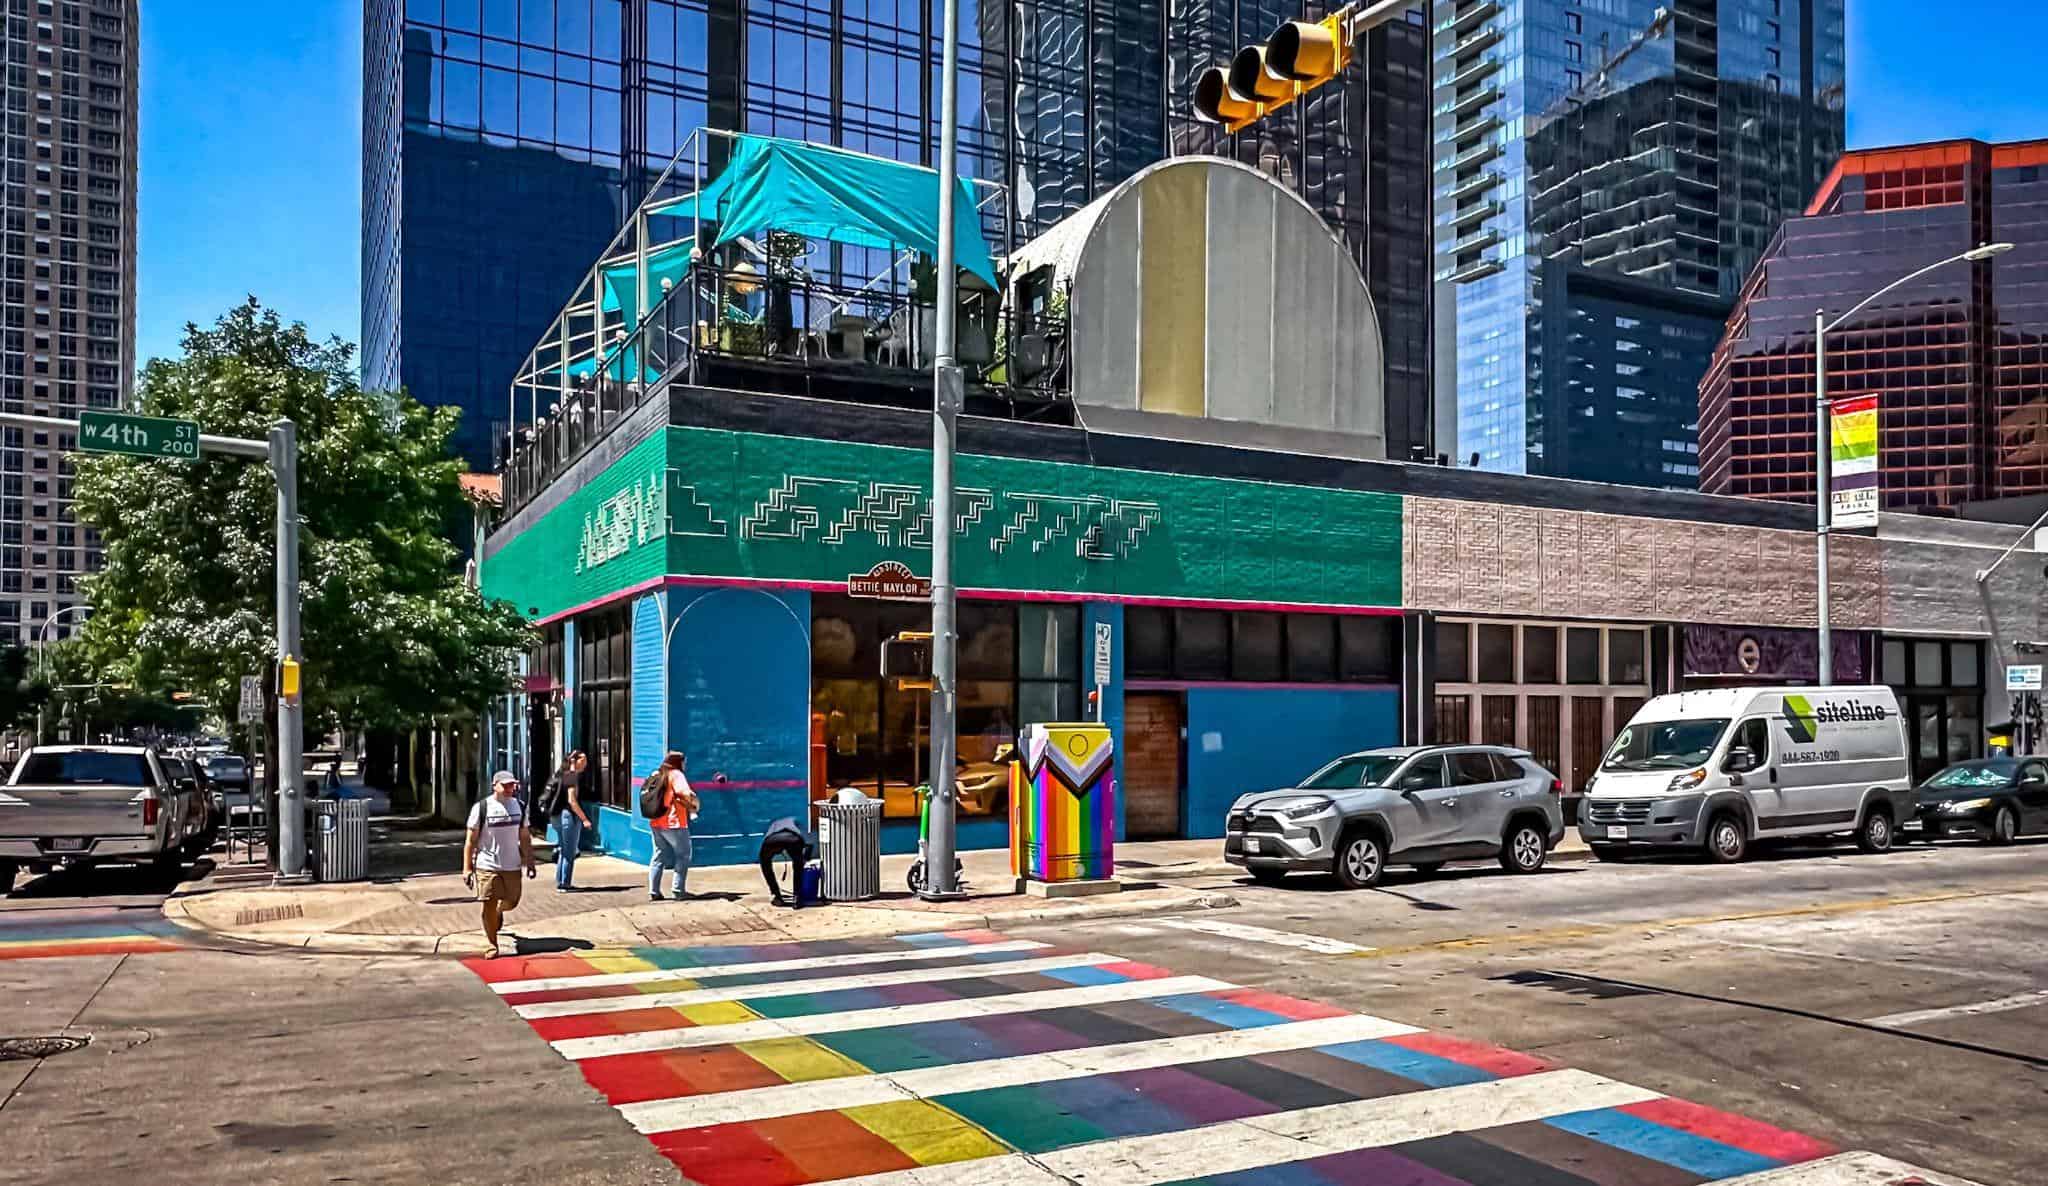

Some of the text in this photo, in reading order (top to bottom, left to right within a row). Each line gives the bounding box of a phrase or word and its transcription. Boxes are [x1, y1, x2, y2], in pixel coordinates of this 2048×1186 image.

[85, 423, 193, 447] W 4th ST
[161, 439, 194, 454] 200
[851, 581, 880, 592] BETTIE
[883, 582, 918, 593] NAYLOR
[1816, 699, 1886, 723] siteline
